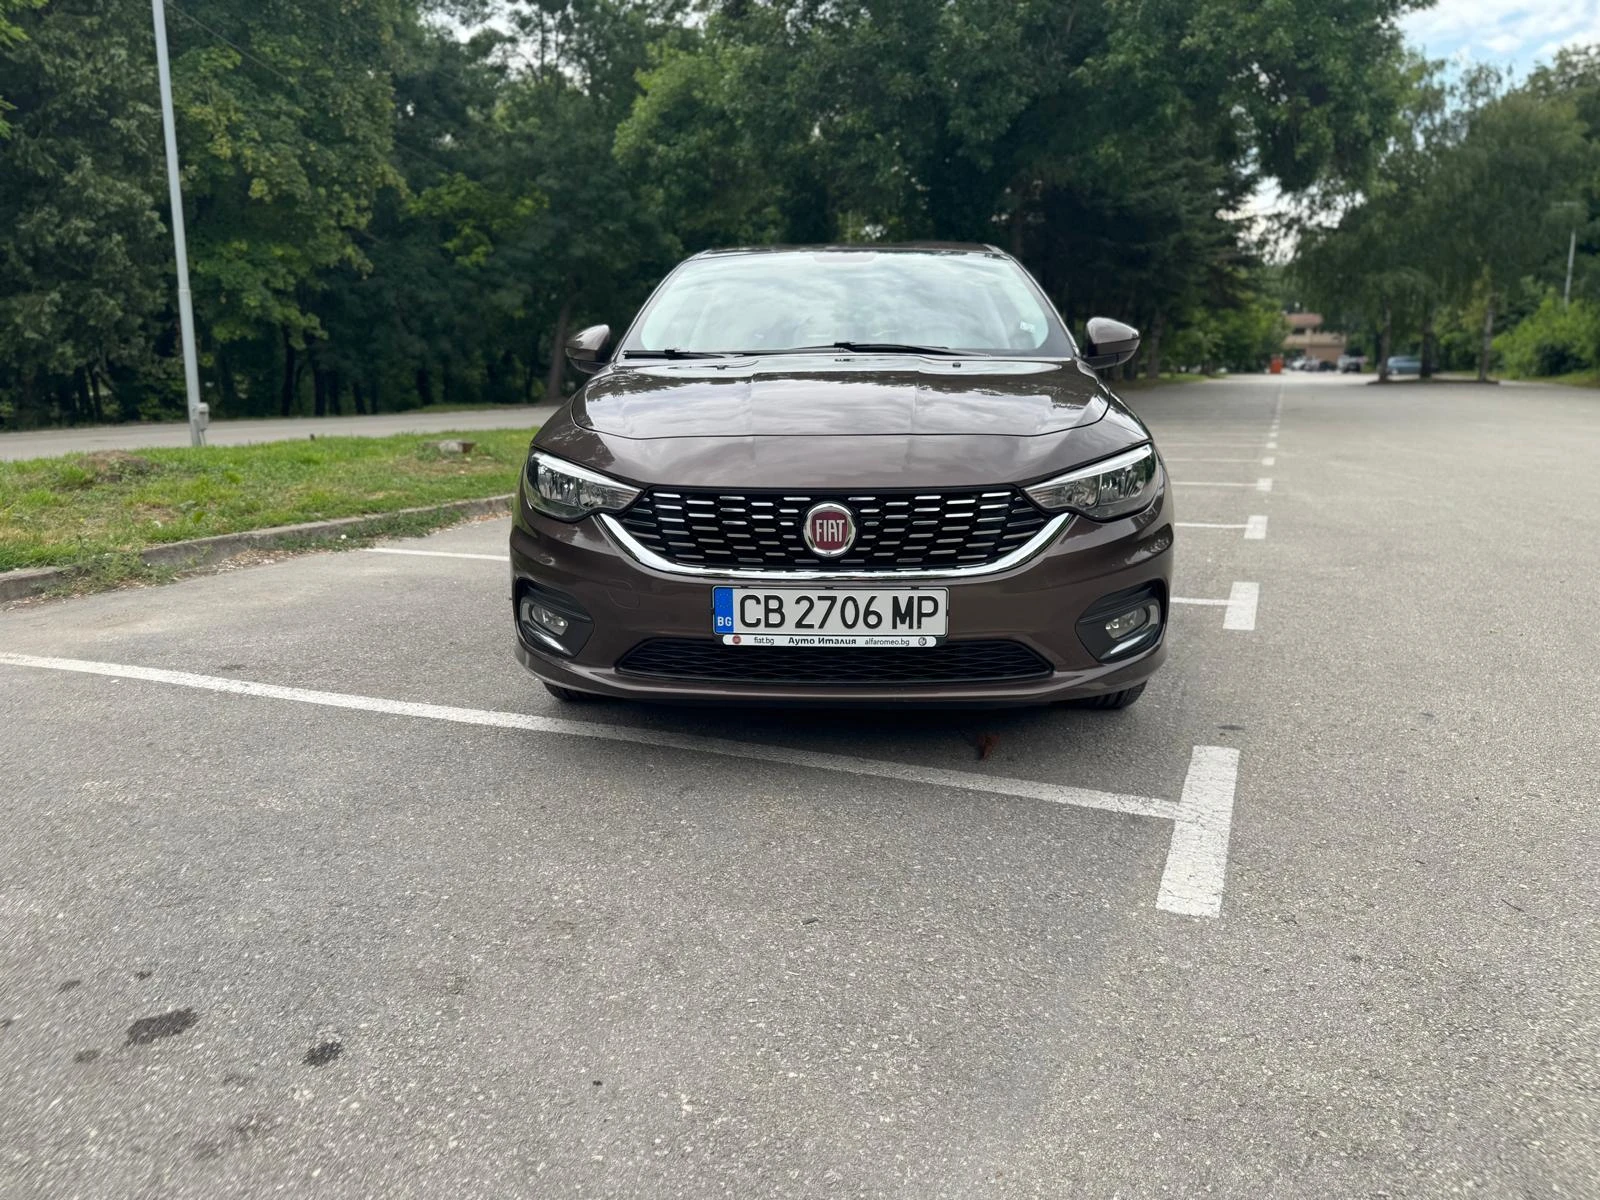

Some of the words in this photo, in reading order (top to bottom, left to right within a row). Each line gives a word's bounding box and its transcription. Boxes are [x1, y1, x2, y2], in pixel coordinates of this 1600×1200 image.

[815, 519, 845, 542] FIAT
[739, 594, 786, 628] CB
[794, 595, 883, 629] 2706
[891, 595, 939, 629] MP
[717, 616, 732, 626] BG
[753, 636, 775, 646] fiat.bg
[788, 637, 815, 646] Ауто
[818, 637, 857, 645] Италия
[864, 637, 910, 647] alfaromeo.bg
